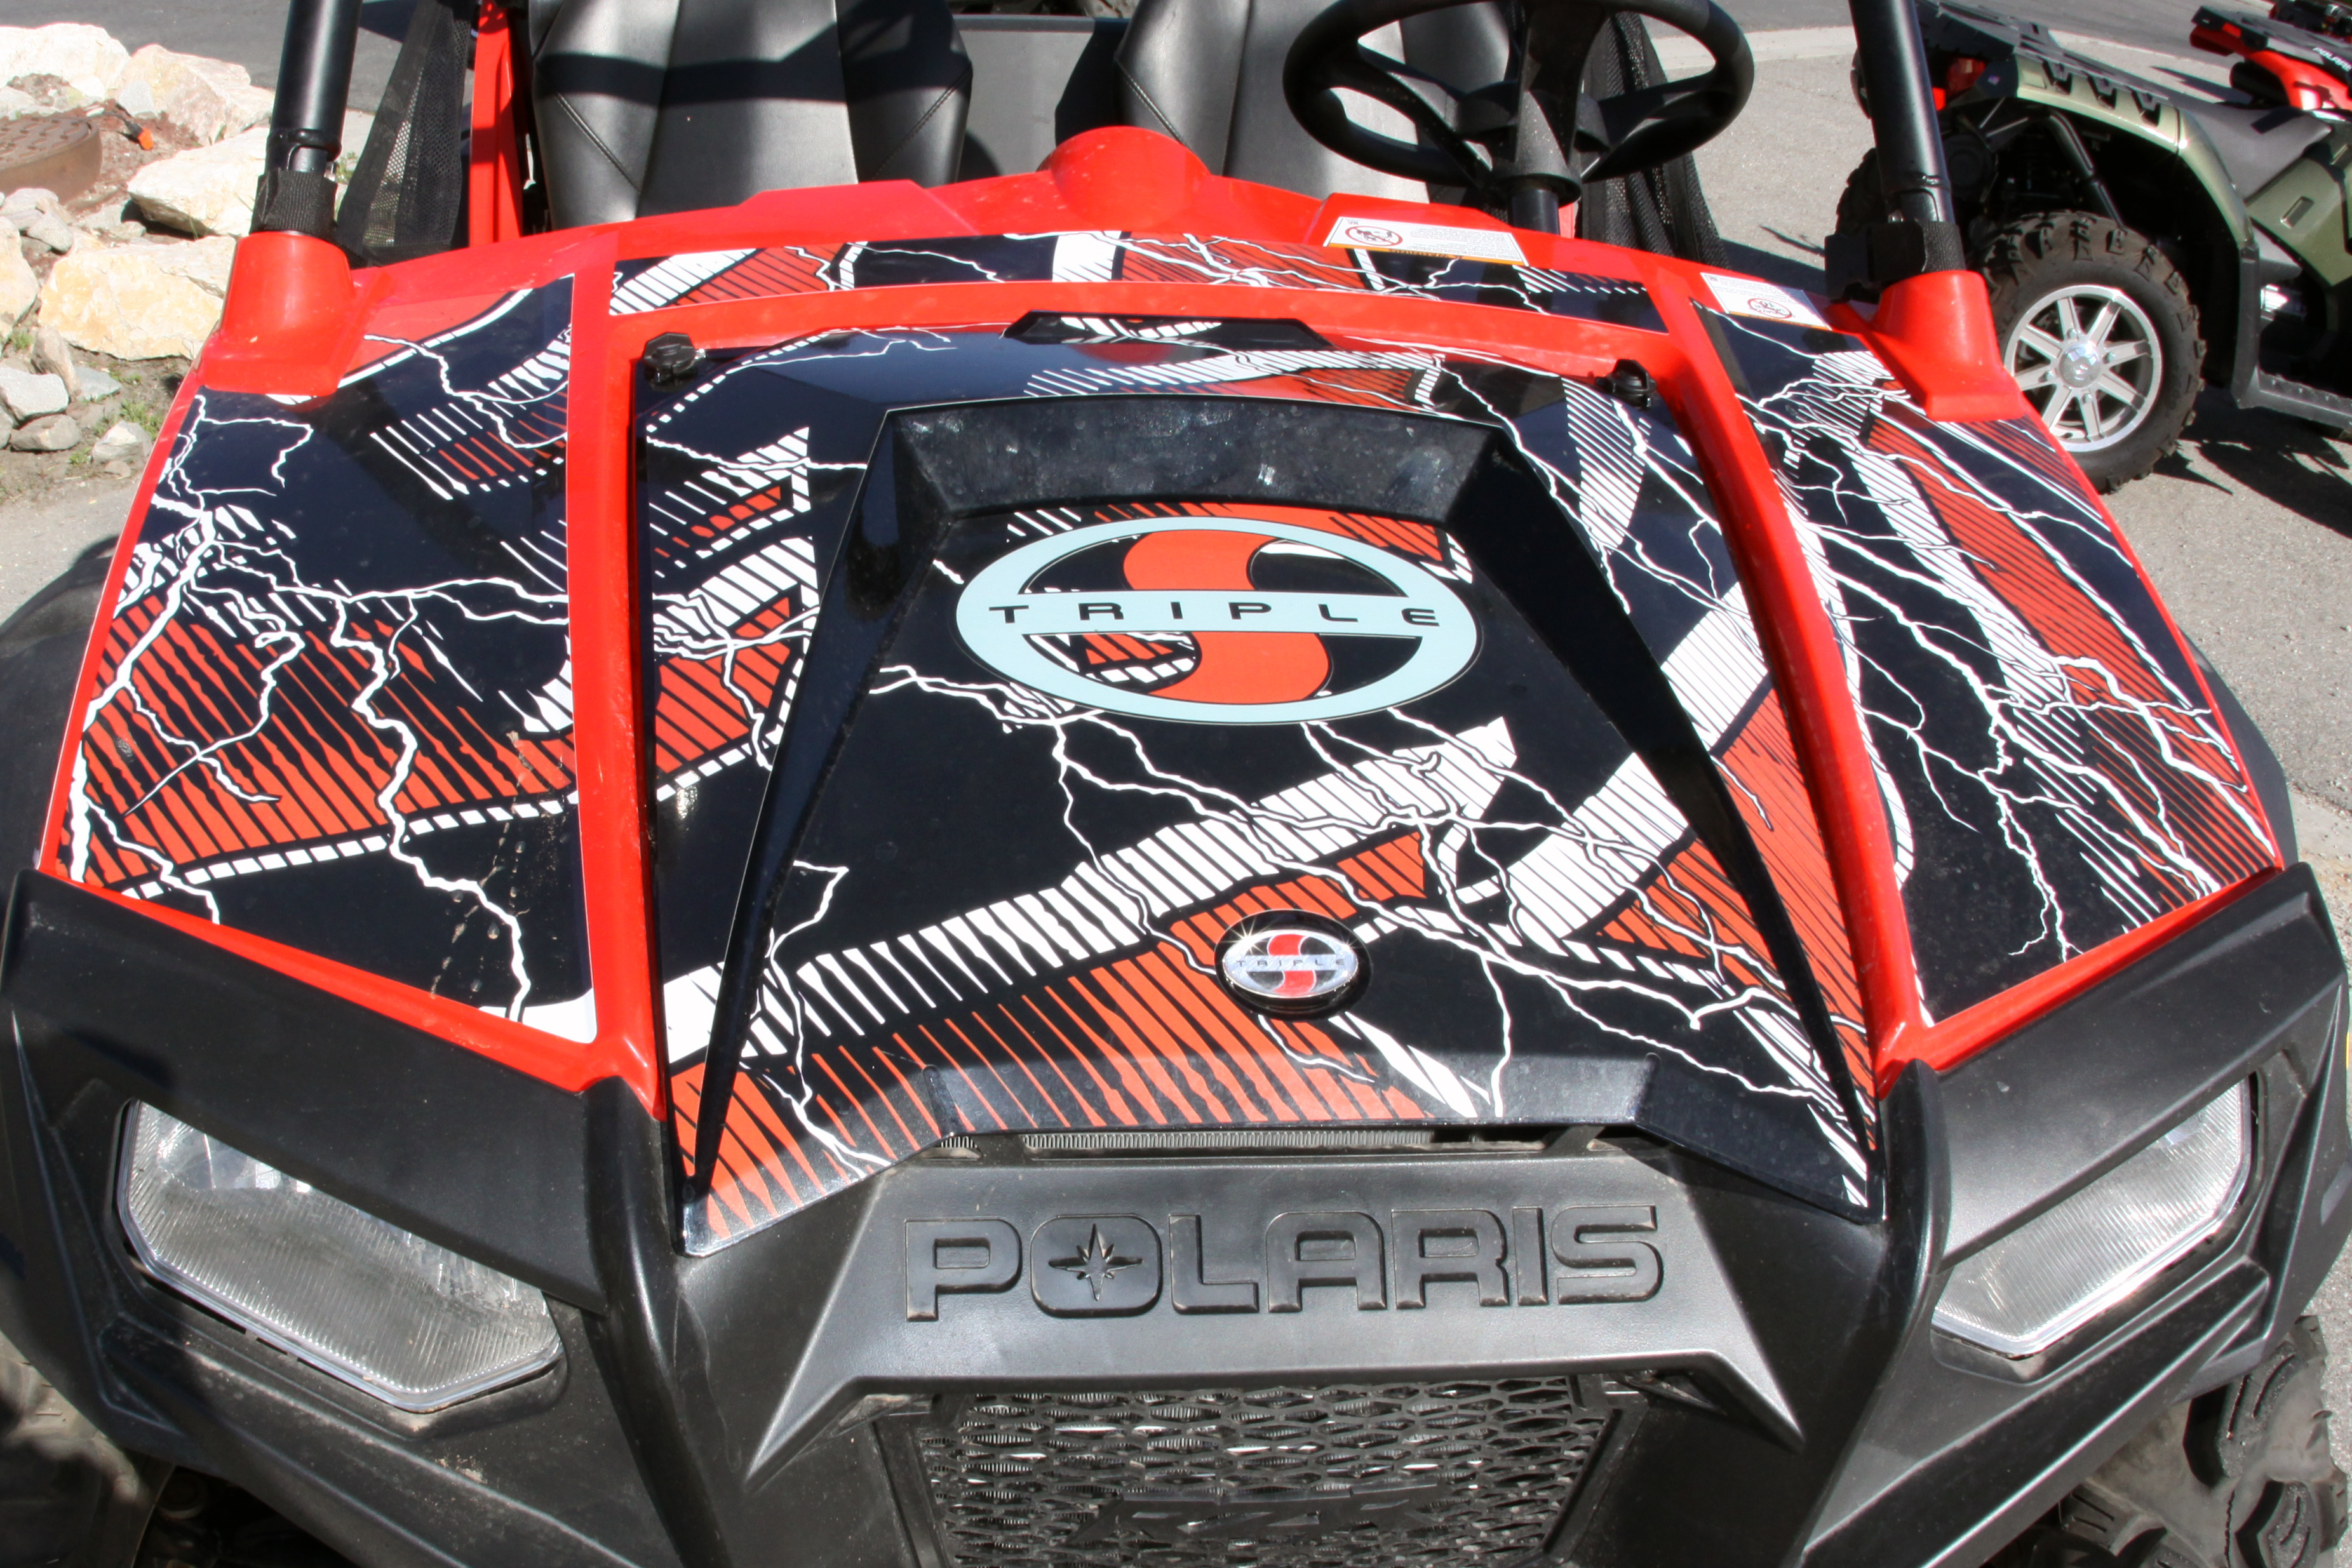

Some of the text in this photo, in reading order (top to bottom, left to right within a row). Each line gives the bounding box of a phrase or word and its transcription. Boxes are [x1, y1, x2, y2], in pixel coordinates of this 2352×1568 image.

[988, 601, 1441, 627] TRIPLE
[1236, 958, 1346, 967] TRIPLE
[904, 1204, 1665, 1323] POLARIS
